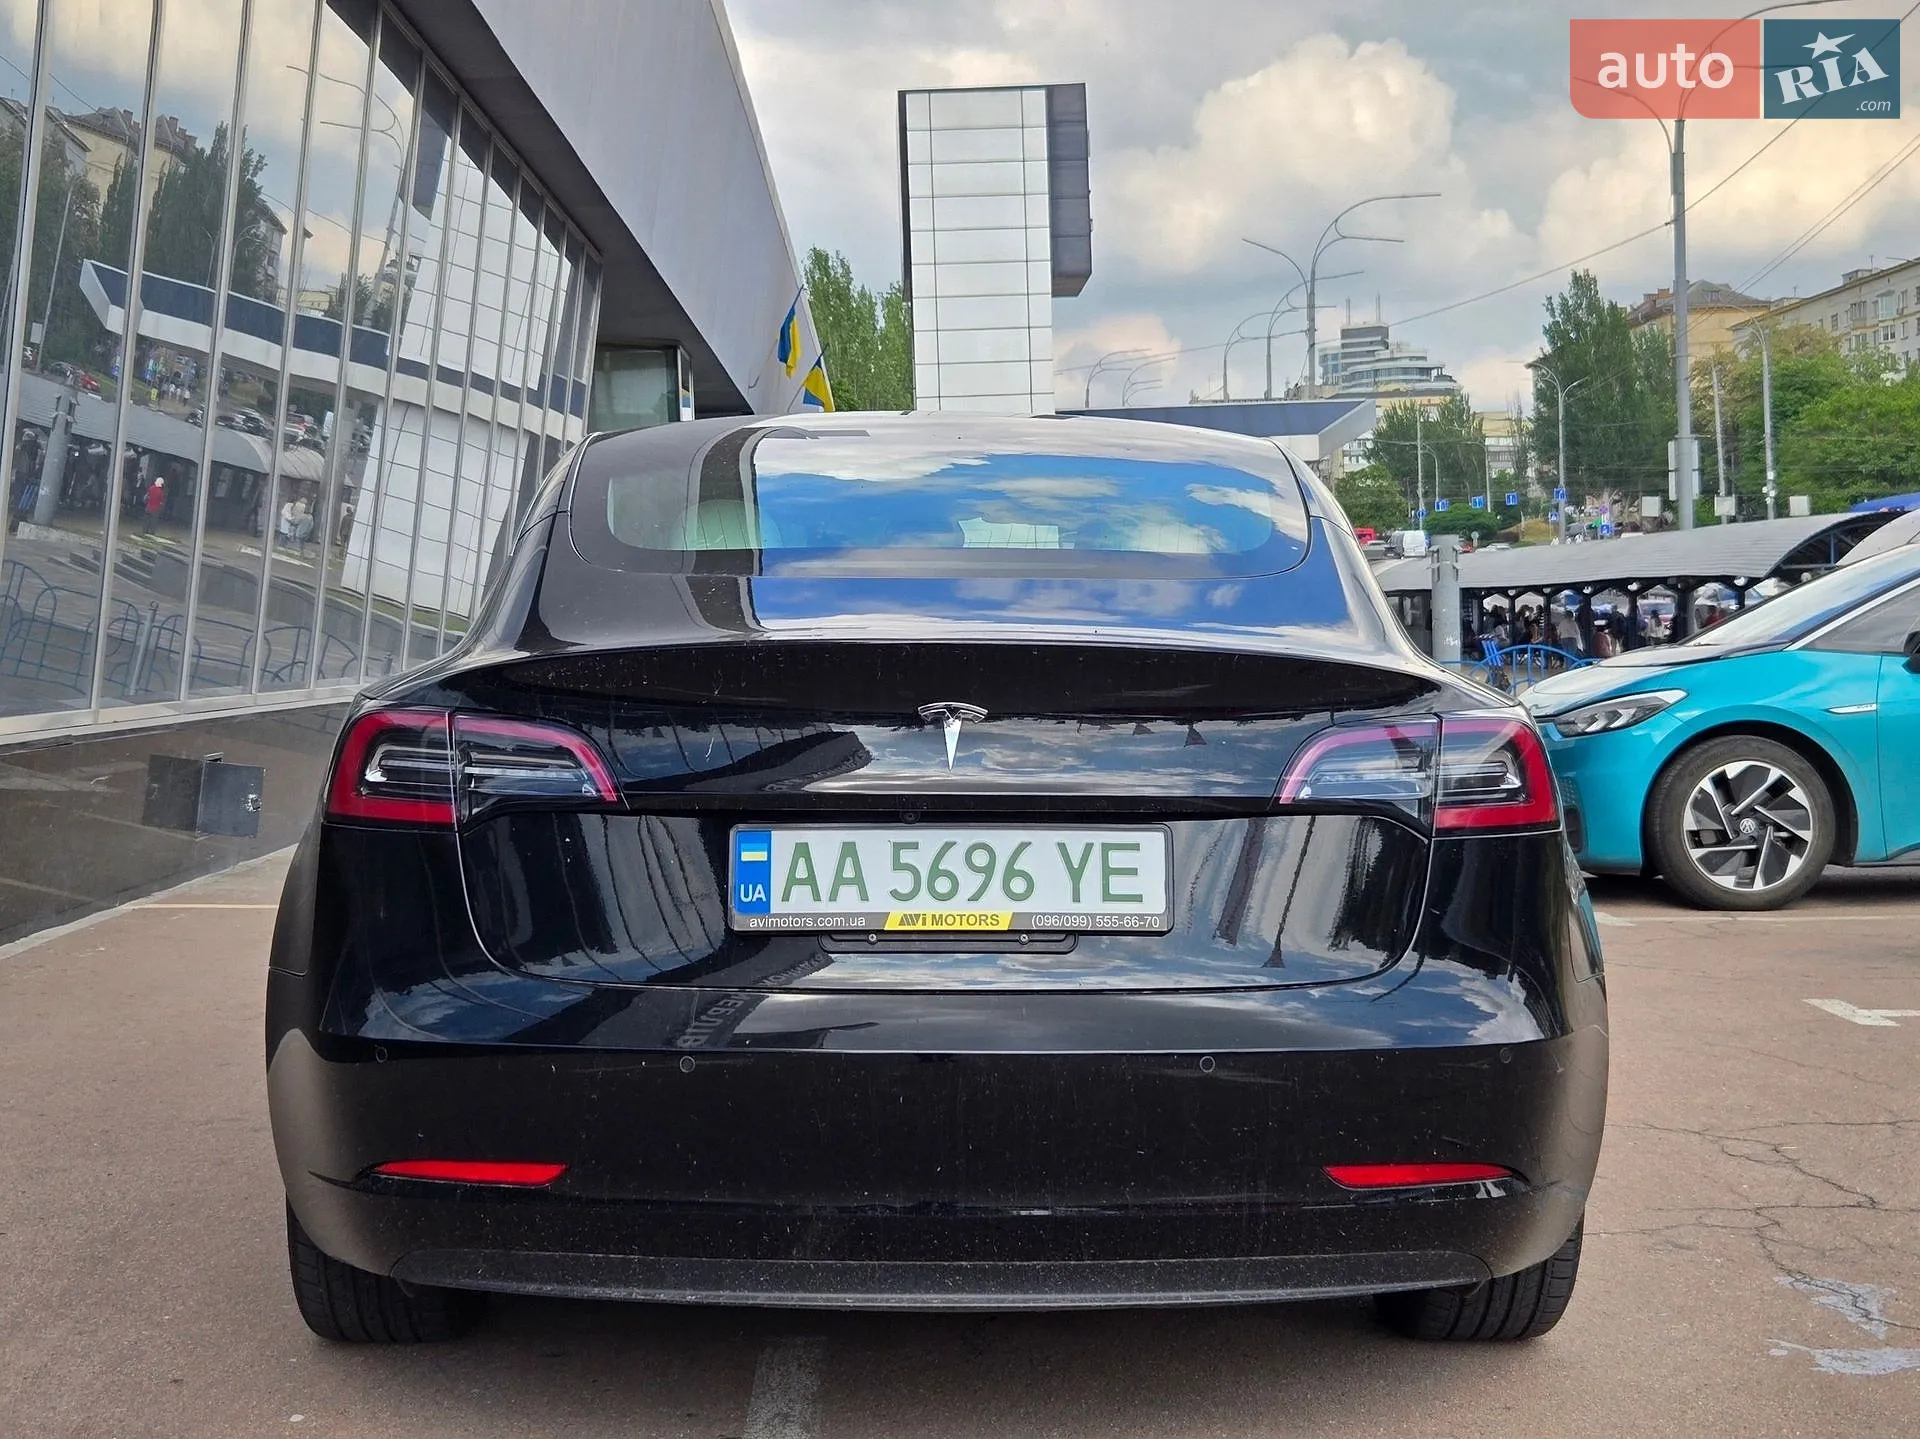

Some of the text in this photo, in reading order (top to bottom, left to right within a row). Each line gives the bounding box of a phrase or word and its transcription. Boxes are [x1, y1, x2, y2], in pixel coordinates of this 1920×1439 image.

[780, 840, 1144, 903] AA 5696 YE
[739, 884, 767, 902] UA
[749, 915, 866, 928] avimotors.com.ua
[931, 913, 1000, 927] MOTORS
[1031, 914, 1160, 929] (096/099) 555-66-70
